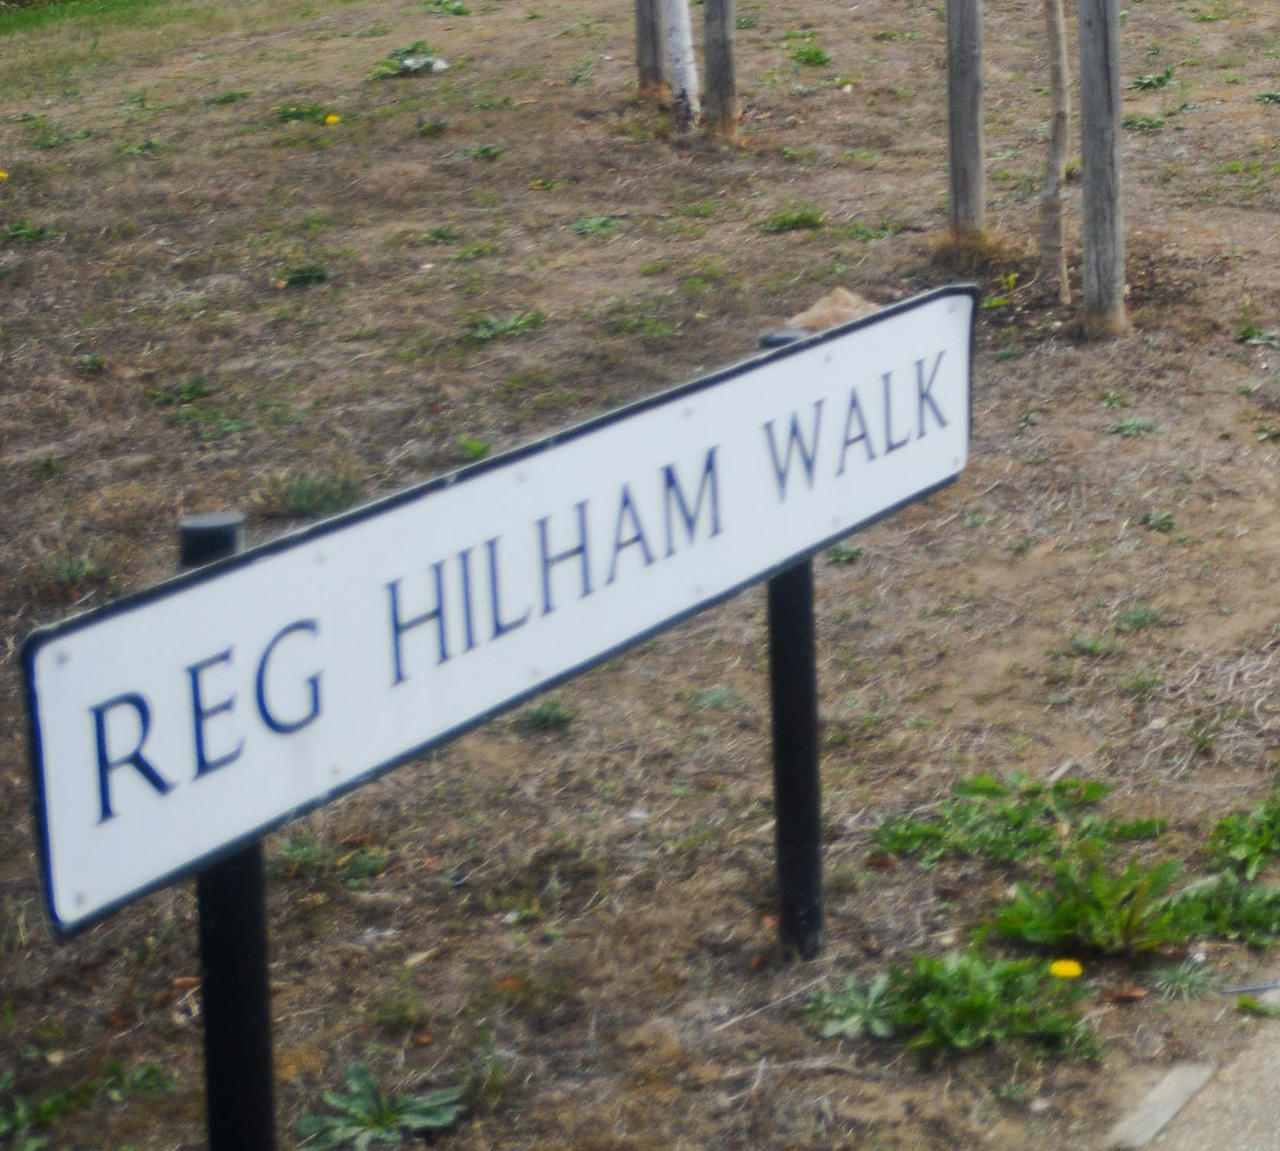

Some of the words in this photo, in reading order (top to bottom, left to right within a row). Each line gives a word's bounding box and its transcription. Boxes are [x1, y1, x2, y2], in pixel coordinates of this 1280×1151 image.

[88, 619, 324, 825] REG
[384, 445, 724, 685] HILHAM
[762, 350, 949, 503] WALK
